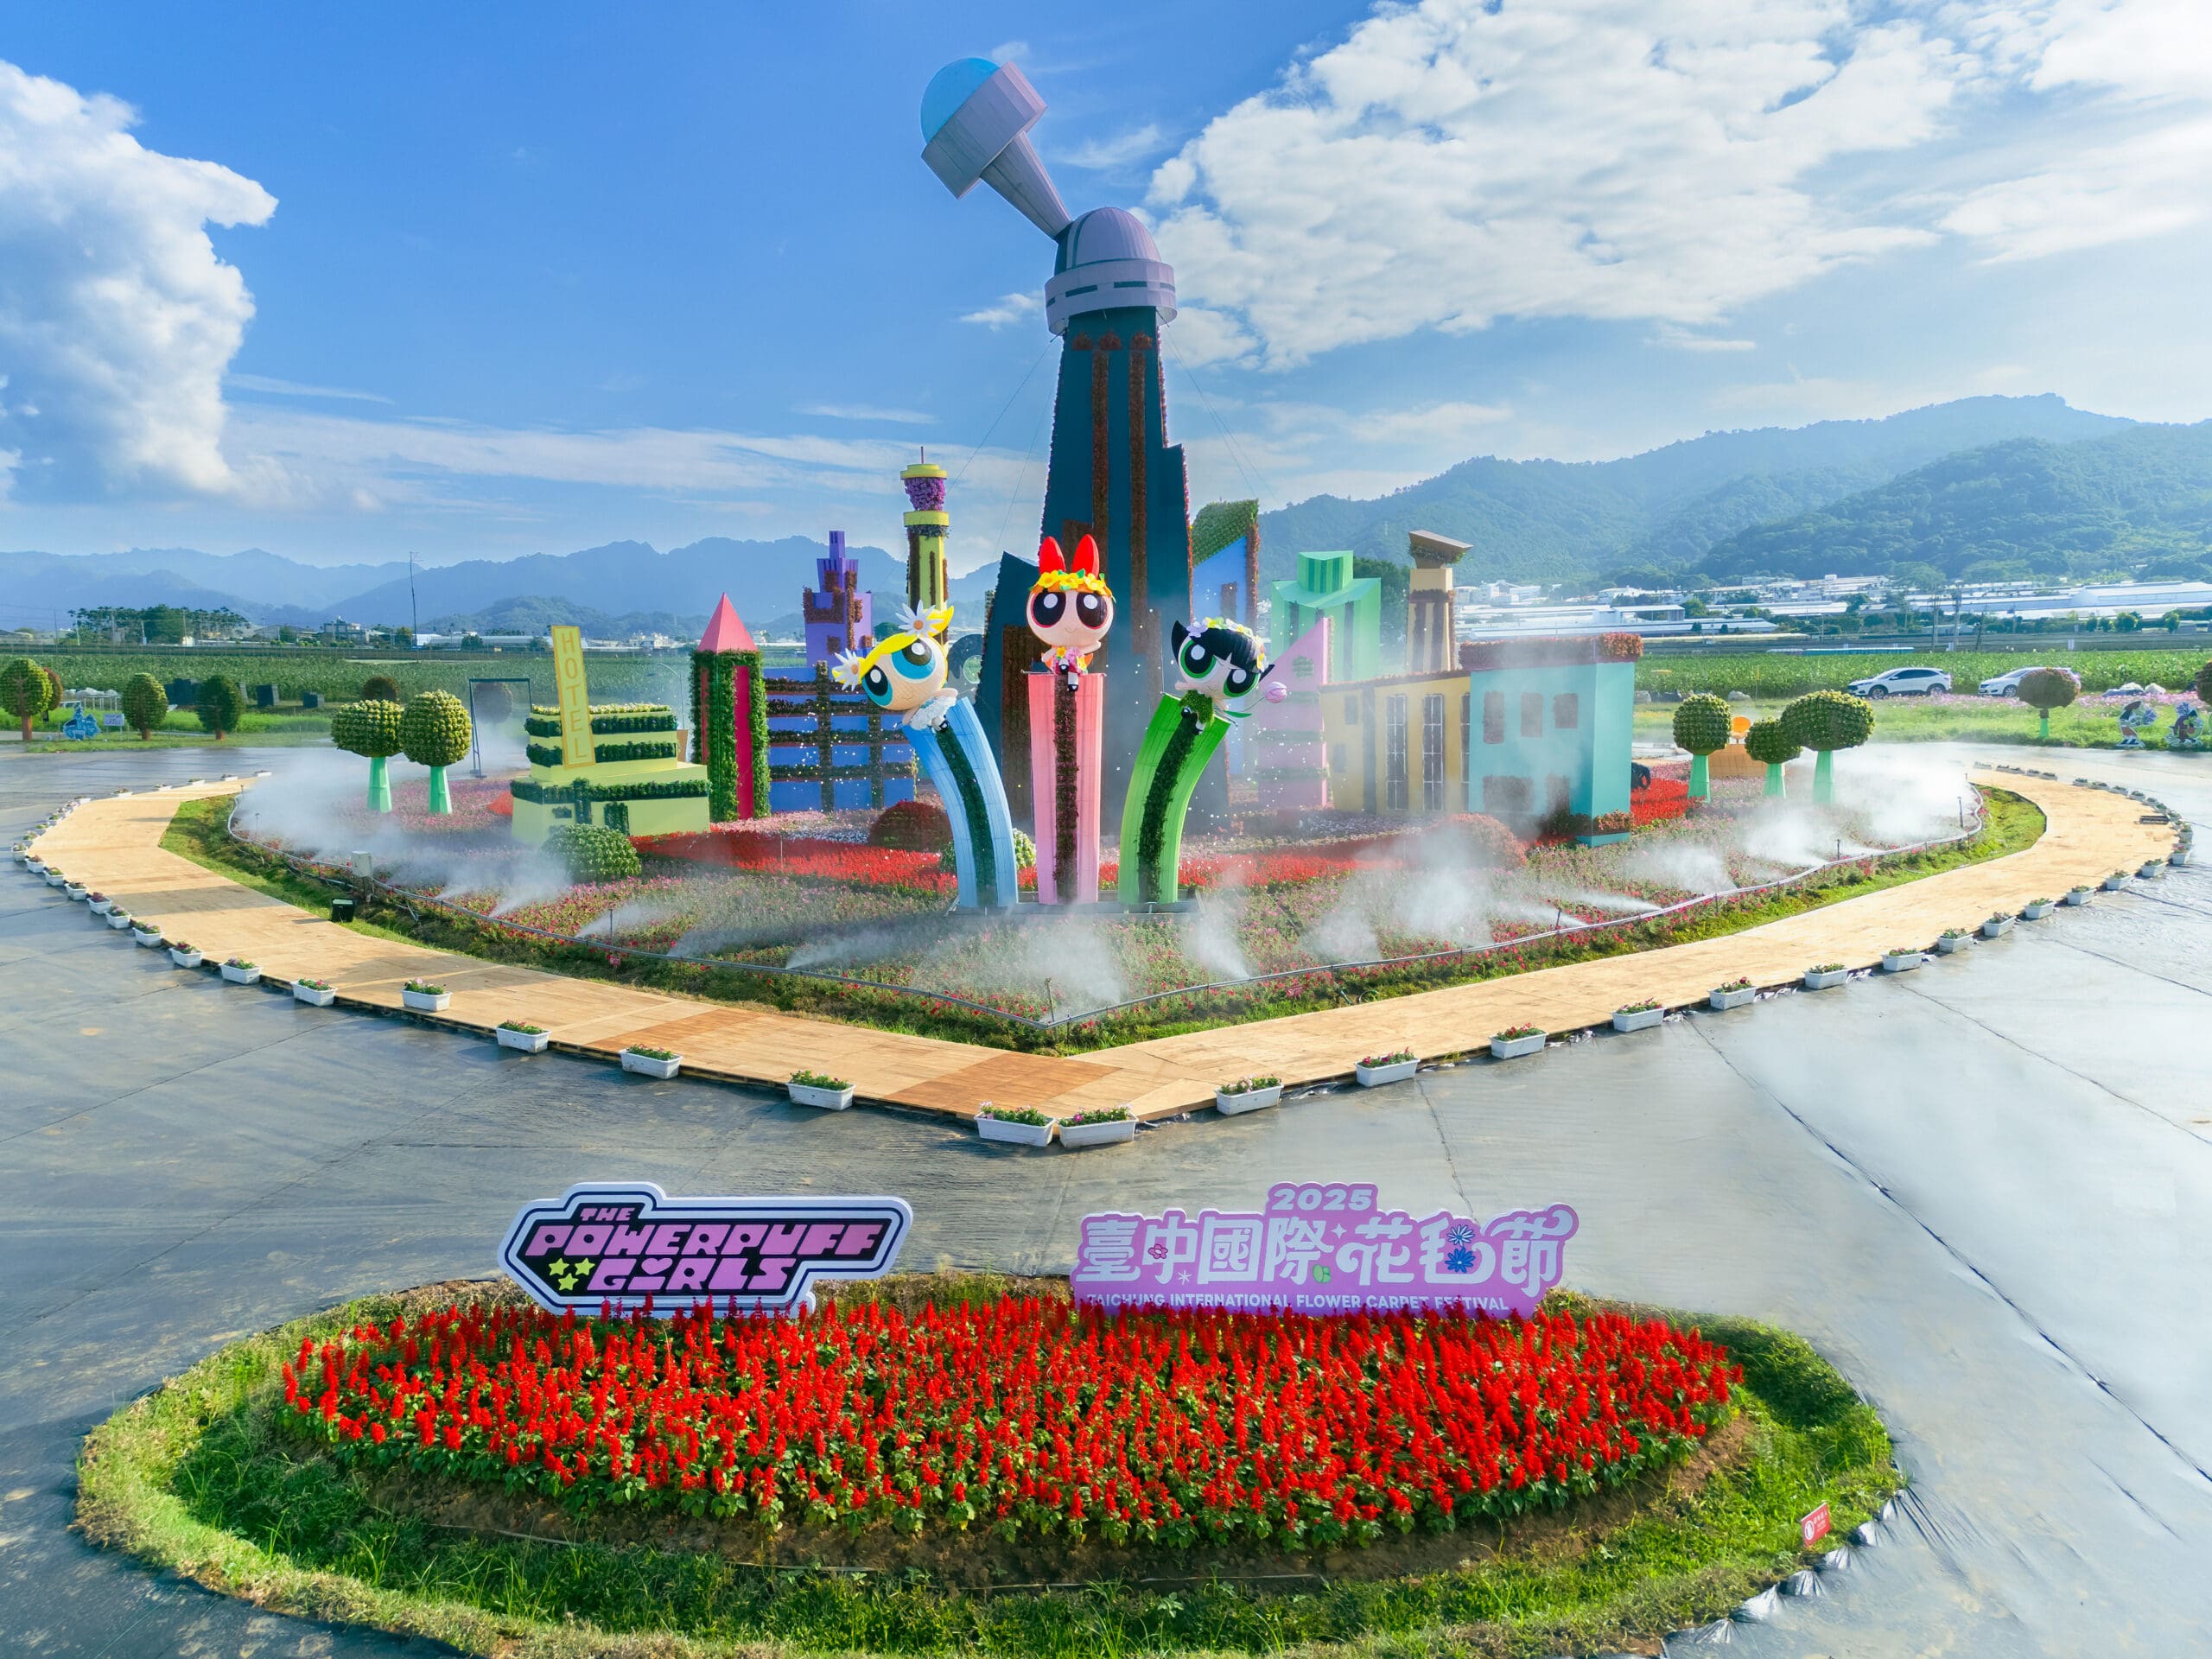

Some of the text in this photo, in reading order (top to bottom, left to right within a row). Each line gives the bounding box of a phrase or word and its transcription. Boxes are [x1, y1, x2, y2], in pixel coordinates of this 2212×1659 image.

[561, 632, 588, 759] HOTEL
[1274, 1188, 1372, 1211] 2025
[580, 1208, 635, 1221] THE
[525, 1224, 883, 1255] POWERPUFF
[587, 1258, 797, 1290] GIRLS
[1087, 1294, 1166, 1306] TAICHUNG
[1170, 1294, 1289, 1307] INTERNATIONAL
[1296, 1294, 1362, 1308] FLOWER
[1366, 1295, 1429, 1309] CARPET
